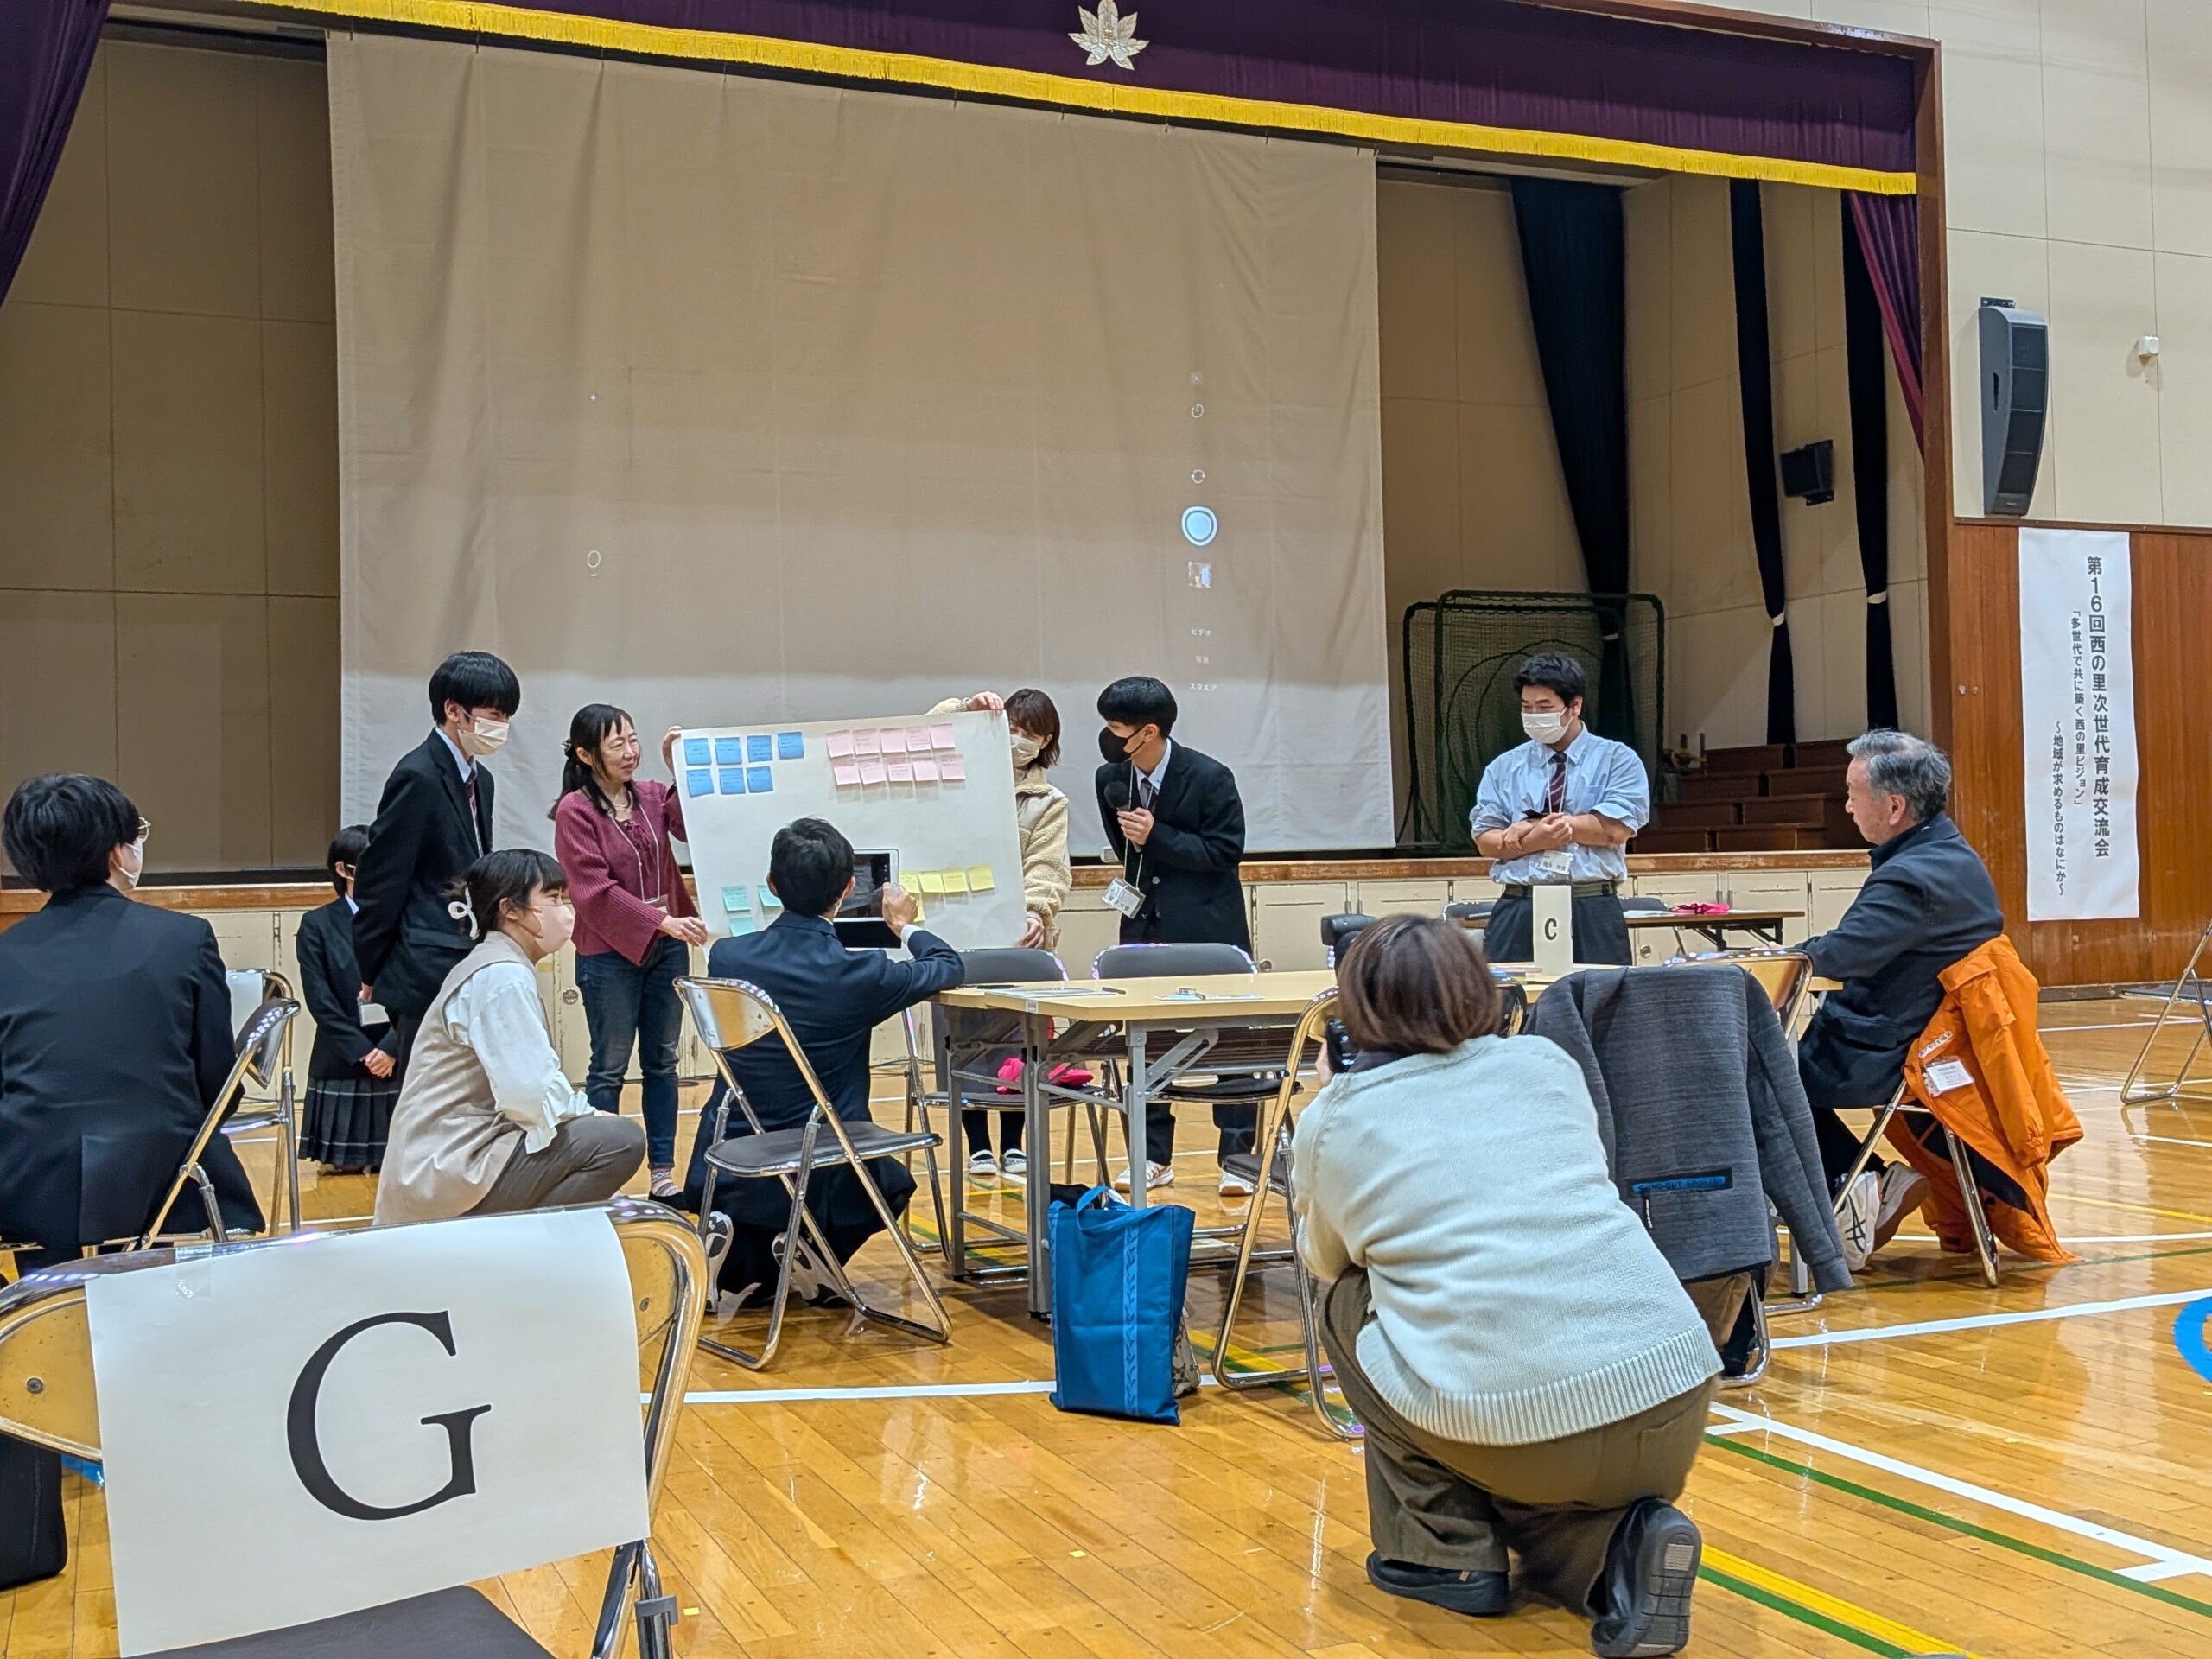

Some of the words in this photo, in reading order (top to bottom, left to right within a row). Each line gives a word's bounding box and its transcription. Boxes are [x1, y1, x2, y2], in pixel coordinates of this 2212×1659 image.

[2087, 556, 2110, 858] 第16回西の里次世代育成交流会
[1544, 918, 1557, 941] C
[287, 1310, 492, 1521] G
